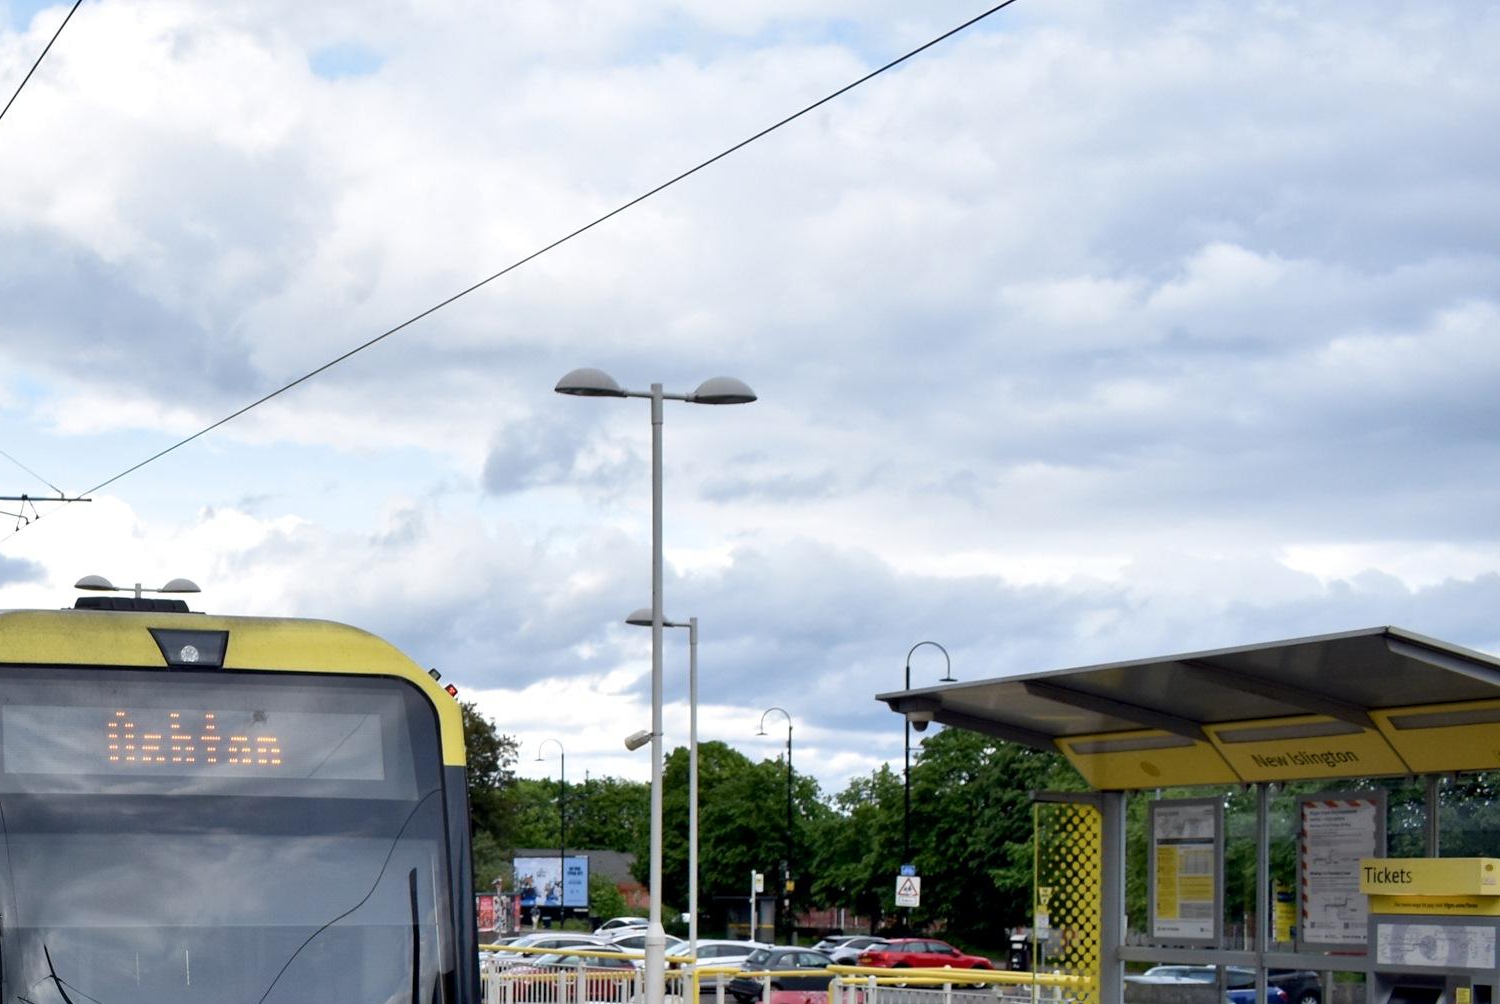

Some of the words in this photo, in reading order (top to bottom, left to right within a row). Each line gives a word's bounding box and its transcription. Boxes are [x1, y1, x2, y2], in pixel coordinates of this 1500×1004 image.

[1250, 754, 1289, 768] New
[1287, 750, 1360, 768] Islington
[1364, 866, 1413, 884] Tickets
